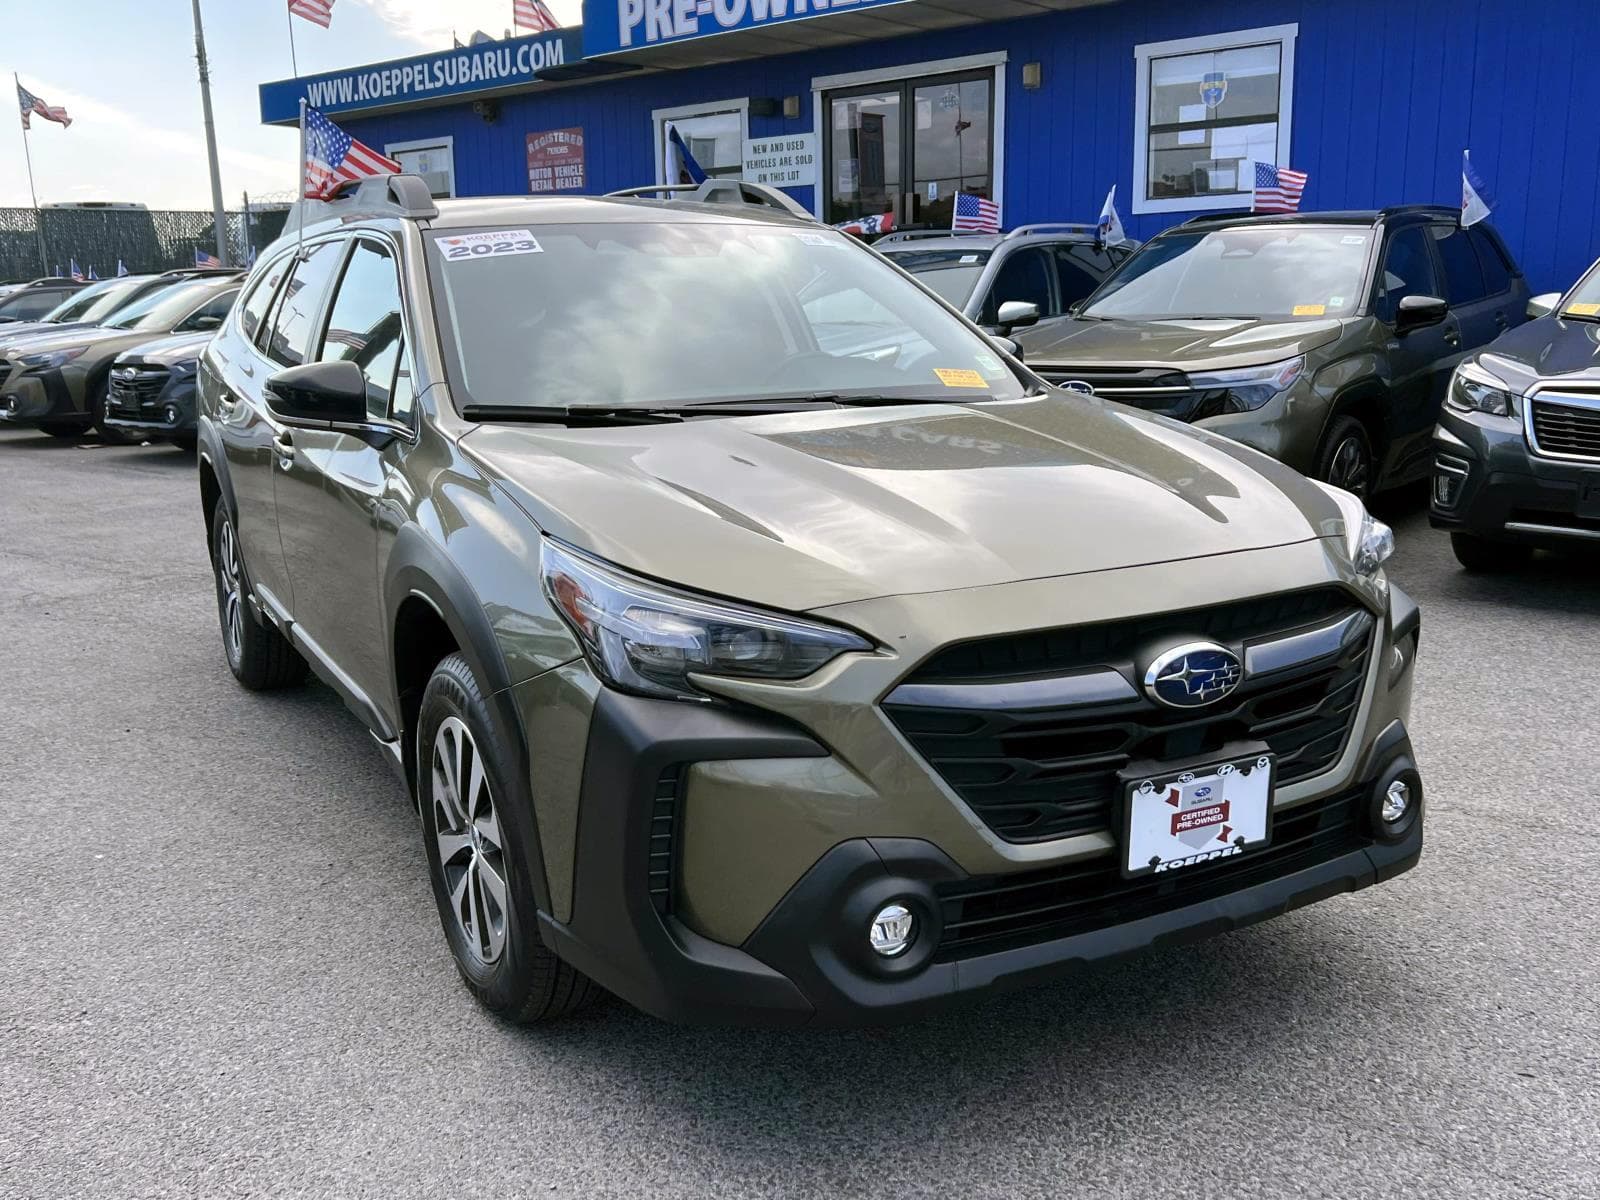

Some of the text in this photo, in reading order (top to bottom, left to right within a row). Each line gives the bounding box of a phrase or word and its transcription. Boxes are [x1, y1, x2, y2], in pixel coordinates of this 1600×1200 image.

[617, 0, 876, 47] PRE-O
[307, 38, 564, 108] WWW.KOEPPELSUBARU.COM
[528, 132, 583, 154] REGISTERED
[752, 140, 805, 154] NEW AND USED
[746, 154, 813, 169] VEHICLES ARE SOLD
[529, 164, 584, 180] MOTOR VEHICLE
[758, 170, 800, 183] ON THIS LOT
[531, 176, 583, 192] RETAIL DEALER
[449, 240, 537, 258] 2023
[1176, 813, 1224, 830] PRE-OWNED
[1181, 807, 1220, 821] CERTIFIED
[1154, 846, 1243, 873] KOEPPEL
